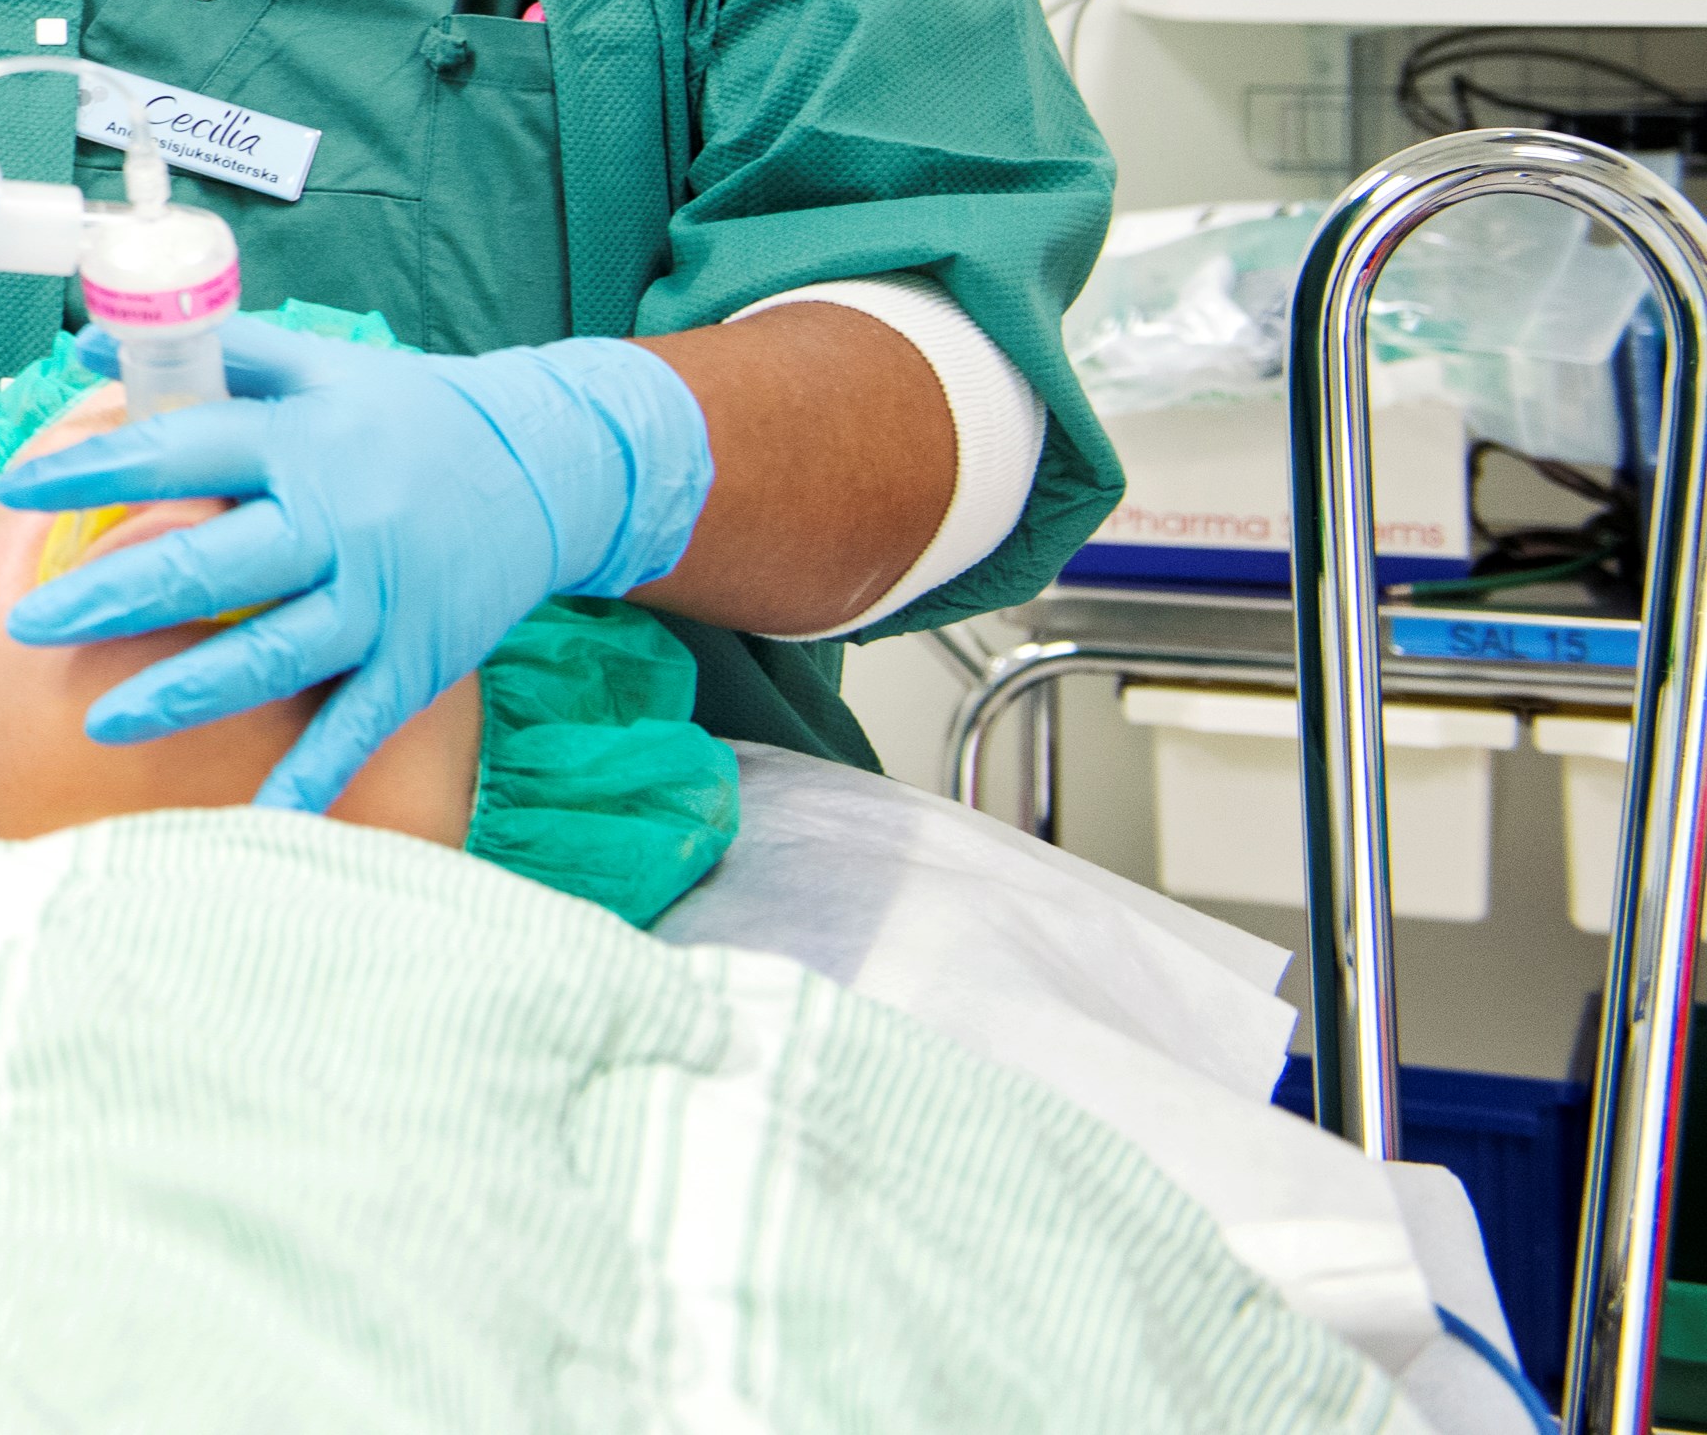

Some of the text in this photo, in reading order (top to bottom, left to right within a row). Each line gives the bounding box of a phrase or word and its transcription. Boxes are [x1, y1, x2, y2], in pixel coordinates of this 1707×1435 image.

[145, 95, 262, 157] Cecilia
[106, 120, 279, 185] Aneesisjuksköterska
[1111, 505, 1271, 541] Pharma
[1450, 622, 1586, 662] SAL 15
